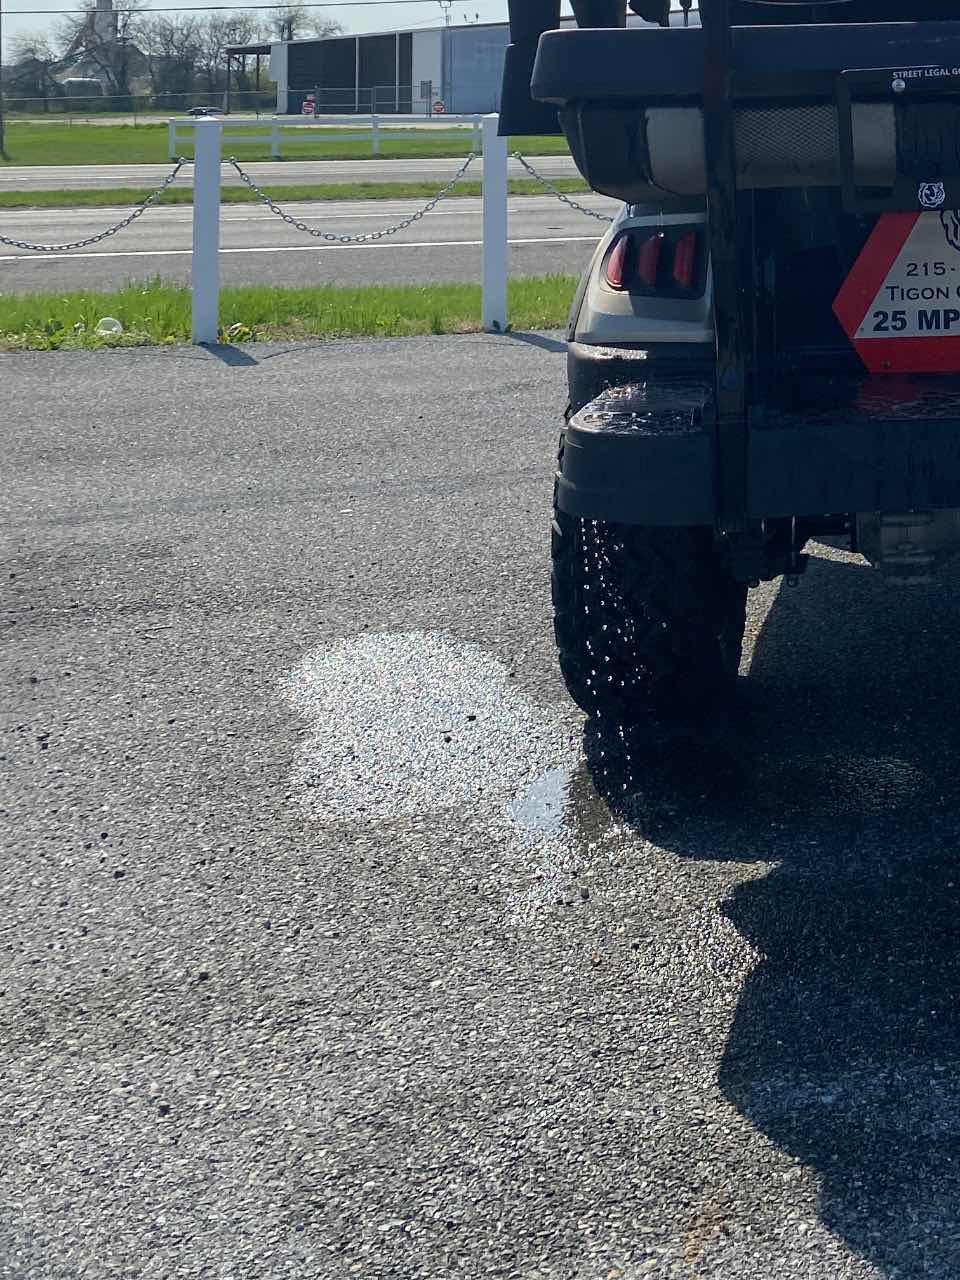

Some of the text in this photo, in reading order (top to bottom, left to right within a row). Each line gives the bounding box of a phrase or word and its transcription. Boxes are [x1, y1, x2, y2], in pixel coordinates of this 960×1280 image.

[892, 69, 922, 79] STREET
[924, 68, 951, 77] LEGAL
[885, 284, 950, 301] TIGON
[872, 310, 907, 332] 25
